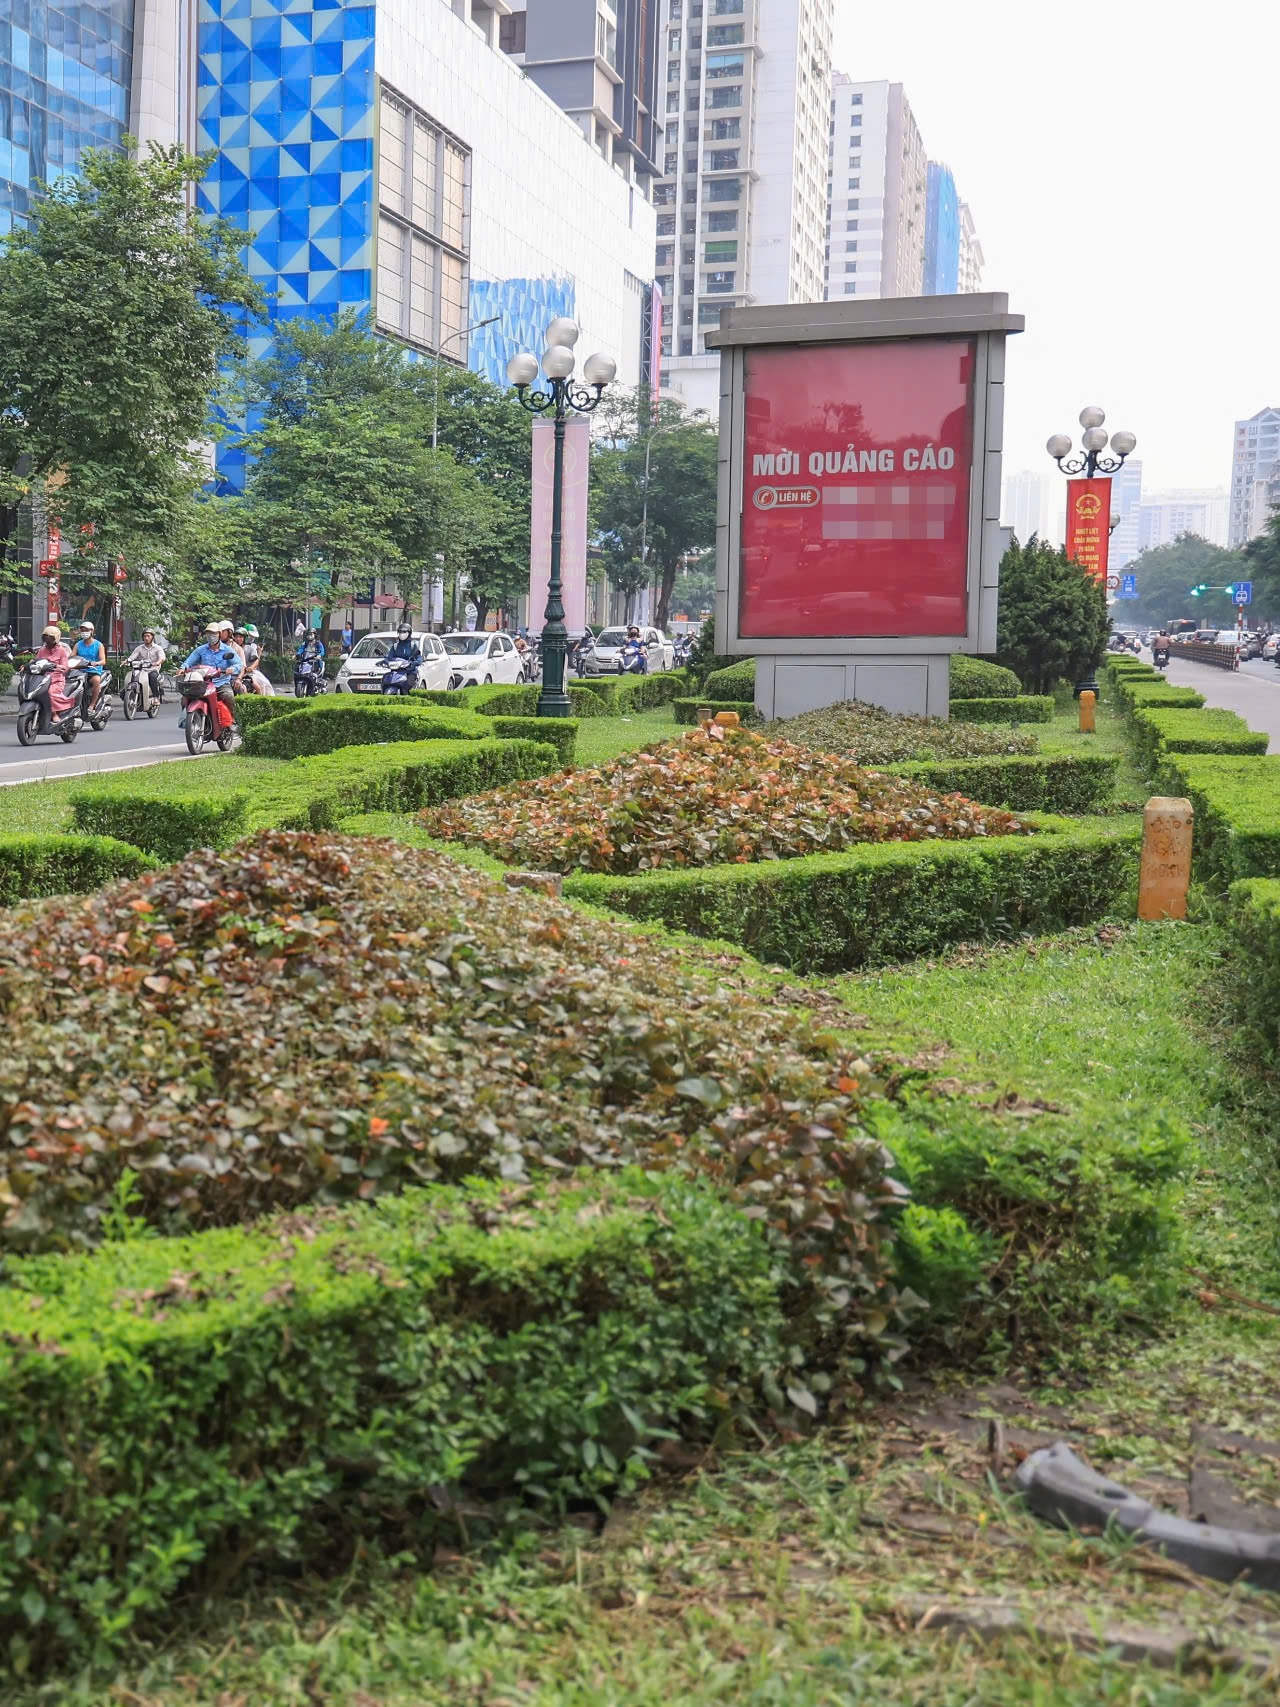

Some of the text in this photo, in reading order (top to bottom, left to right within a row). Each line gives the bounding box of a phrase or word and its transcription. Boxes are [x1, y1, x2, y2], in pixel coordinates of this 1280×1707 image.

[752, 442, 955, 476] MỜI QUẢNG CÁO
[778, 490, 812, 502] LIÊN HỆ
